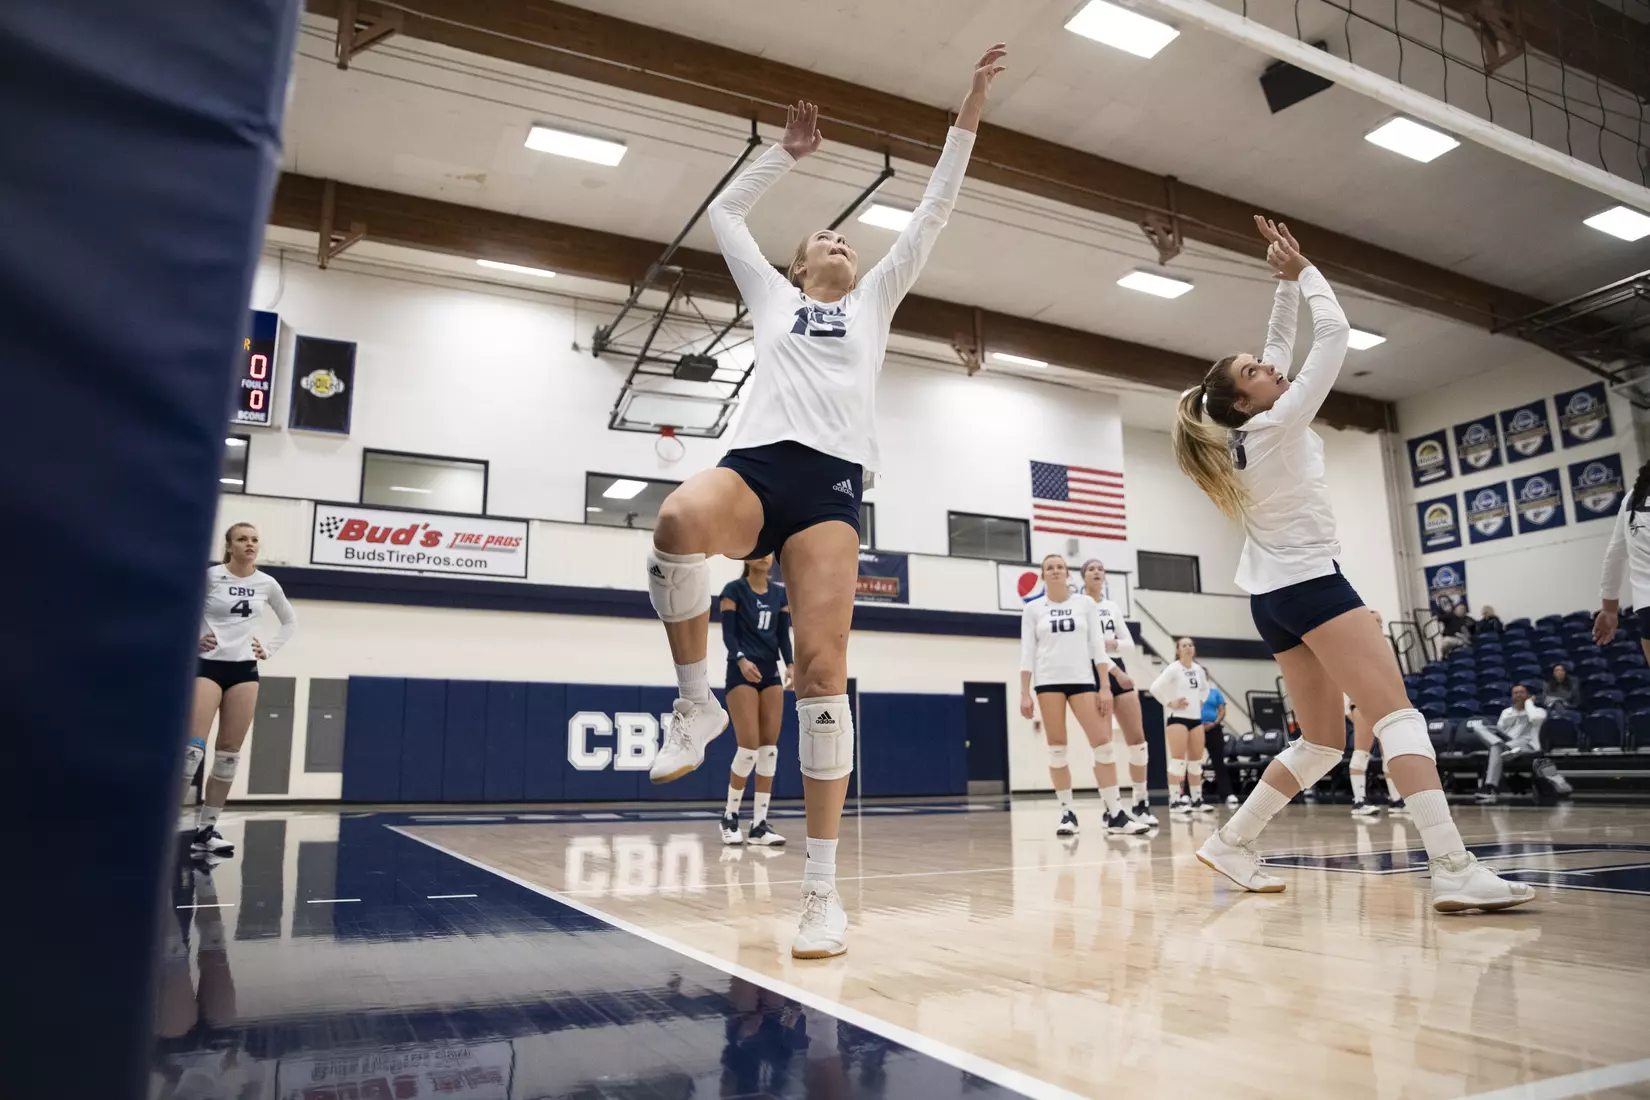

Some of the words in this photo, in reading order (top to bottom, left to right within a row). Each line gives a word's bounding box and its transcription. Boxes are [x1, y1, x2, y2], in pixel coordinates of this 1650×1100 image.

[790, 306, 847, 338] 15
[249, 354, 268, 379] 0
[249, 389, 264, 410] 0
[336, 518, 443, 548] Bud's
[450, 532, 483, 549] TIRE
[482, 535, 523, 551] PROS
[344, 547, 488, 569] BudsTirePros.com
[228, 586, 255, 597] CBU
[230, 600, 252, 618] 4
[757, 610, 772, 630] 11
[1049, 618, 1076, 633] 10
[1100, 619, 1115, 634] 14
[1189, 678, 1198, 689] 9
[567, 711, 673, 771] CB
